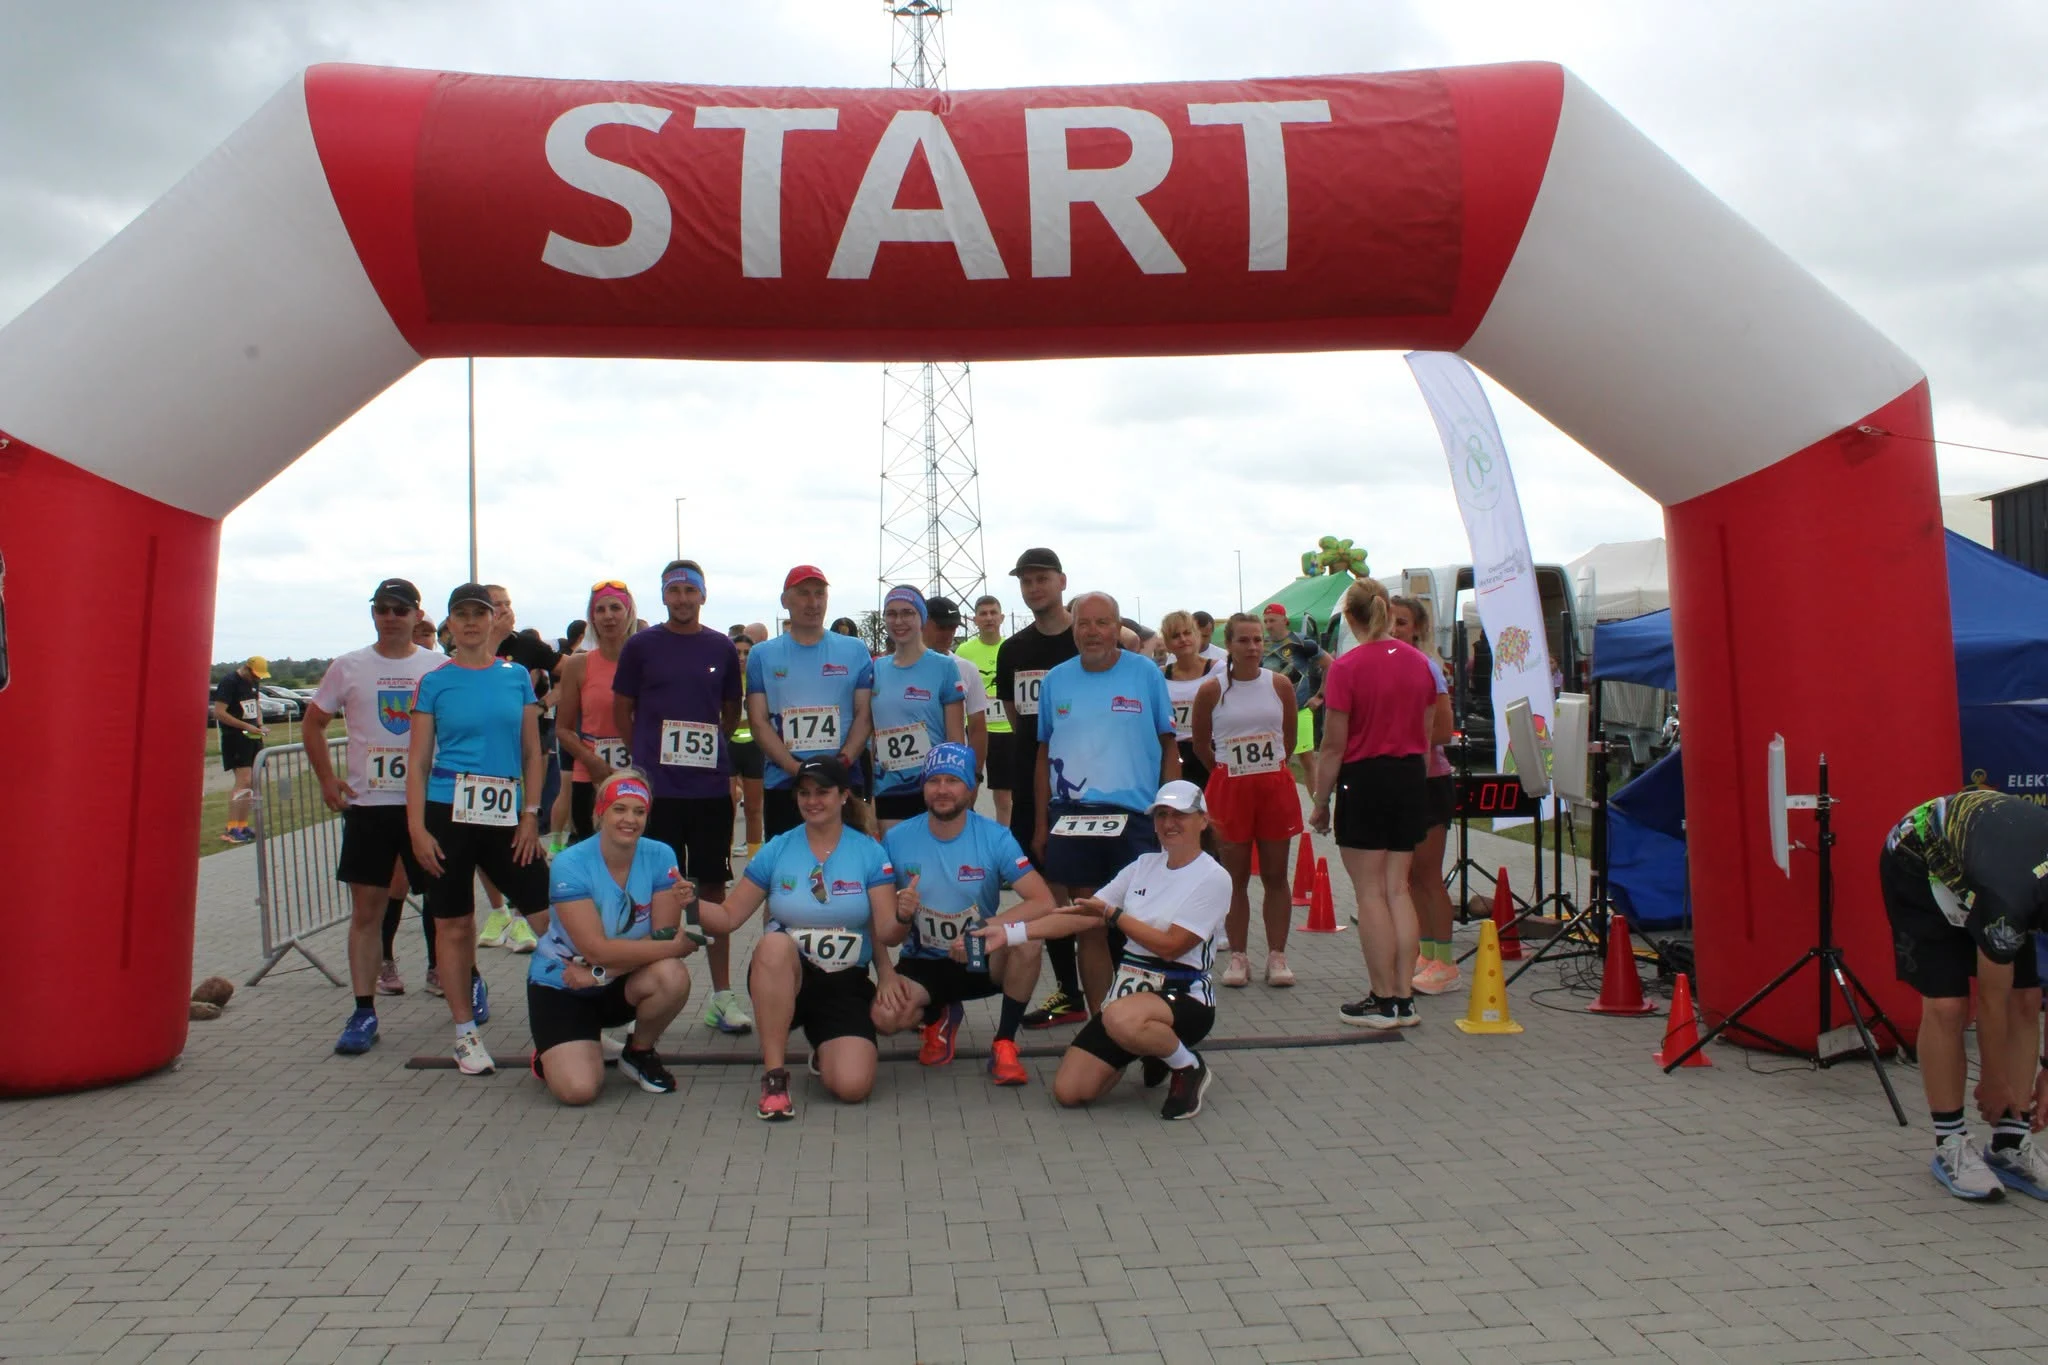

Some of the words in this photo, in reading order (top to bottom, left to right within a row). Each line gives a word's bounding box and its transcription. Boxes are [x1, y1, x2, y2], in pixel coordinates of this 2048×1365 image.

[541, 99, 1332, 281] START
[1019, 679, 1042, 702] 10
[789, 714, 836, 739] 174
[669, 730, 714, 756] 153
[887, 734, 919, 759] 82
[1232, 741, 1274, 765] 184
[373, 755, 406, 778] 16
[601, 746, 631, 768] 13
[2007, 774, 2048, 788] ELEK
[464, 785, 512, 813] 190
[1066, 820, 1120, 832] 119
[799, 933, 857, 959] 167
